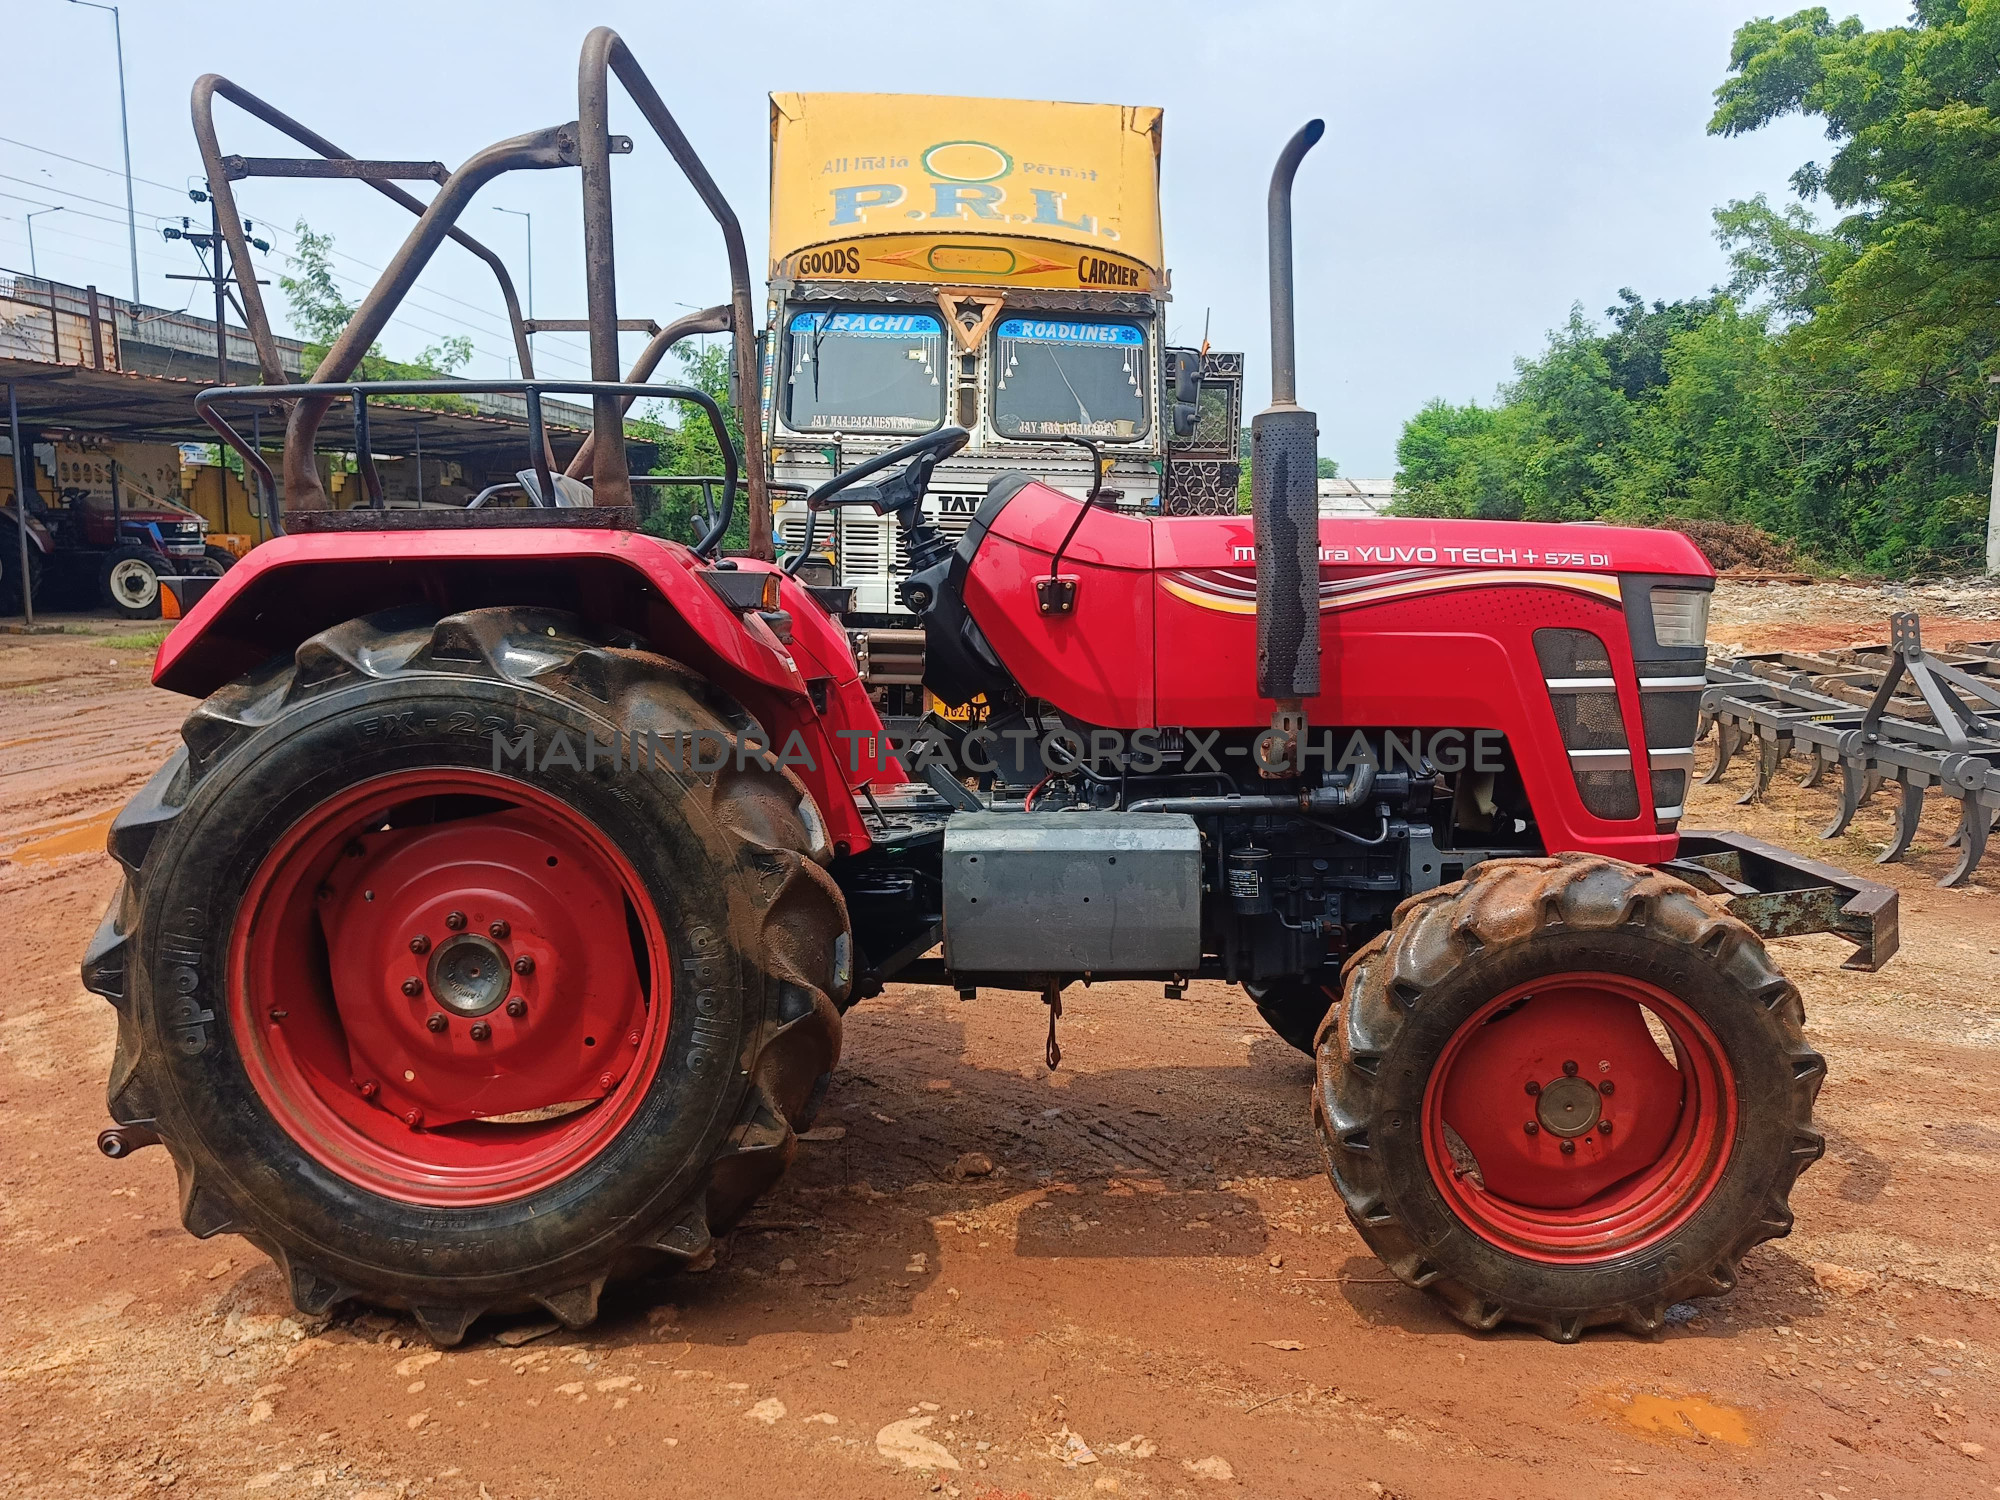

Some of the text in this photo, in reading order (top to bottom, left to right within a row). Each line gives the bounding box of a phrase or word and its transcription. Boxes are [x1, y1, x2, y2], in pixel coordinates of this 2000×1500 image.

[854, 156, 909, 171] India
[828, 182, 1121, 241] P.R.L.
[799, 247, 860, 275] GOODS
[1077, 255, 1139, 287] CARRIER
[1021, 322, 1120, 342] ROADLINES
[811, 415, 828, 427] JAY
[830, 415, 848, 428] MAA
[1019, 421, 1038, 434] JAY
[1040, 421, 1061, 435] MAA
[938, 496, 986, 513] TAT
[1355, 546, 1438, 562] YUVO
[1443, 548, 1517, 564] TECH
[1544, 552, 1585, 566] 575
[1589, 553, 1609, 567] DI
[161, 906, 215, 1056] apollo
[682, 926, 734, 1075] apollo
